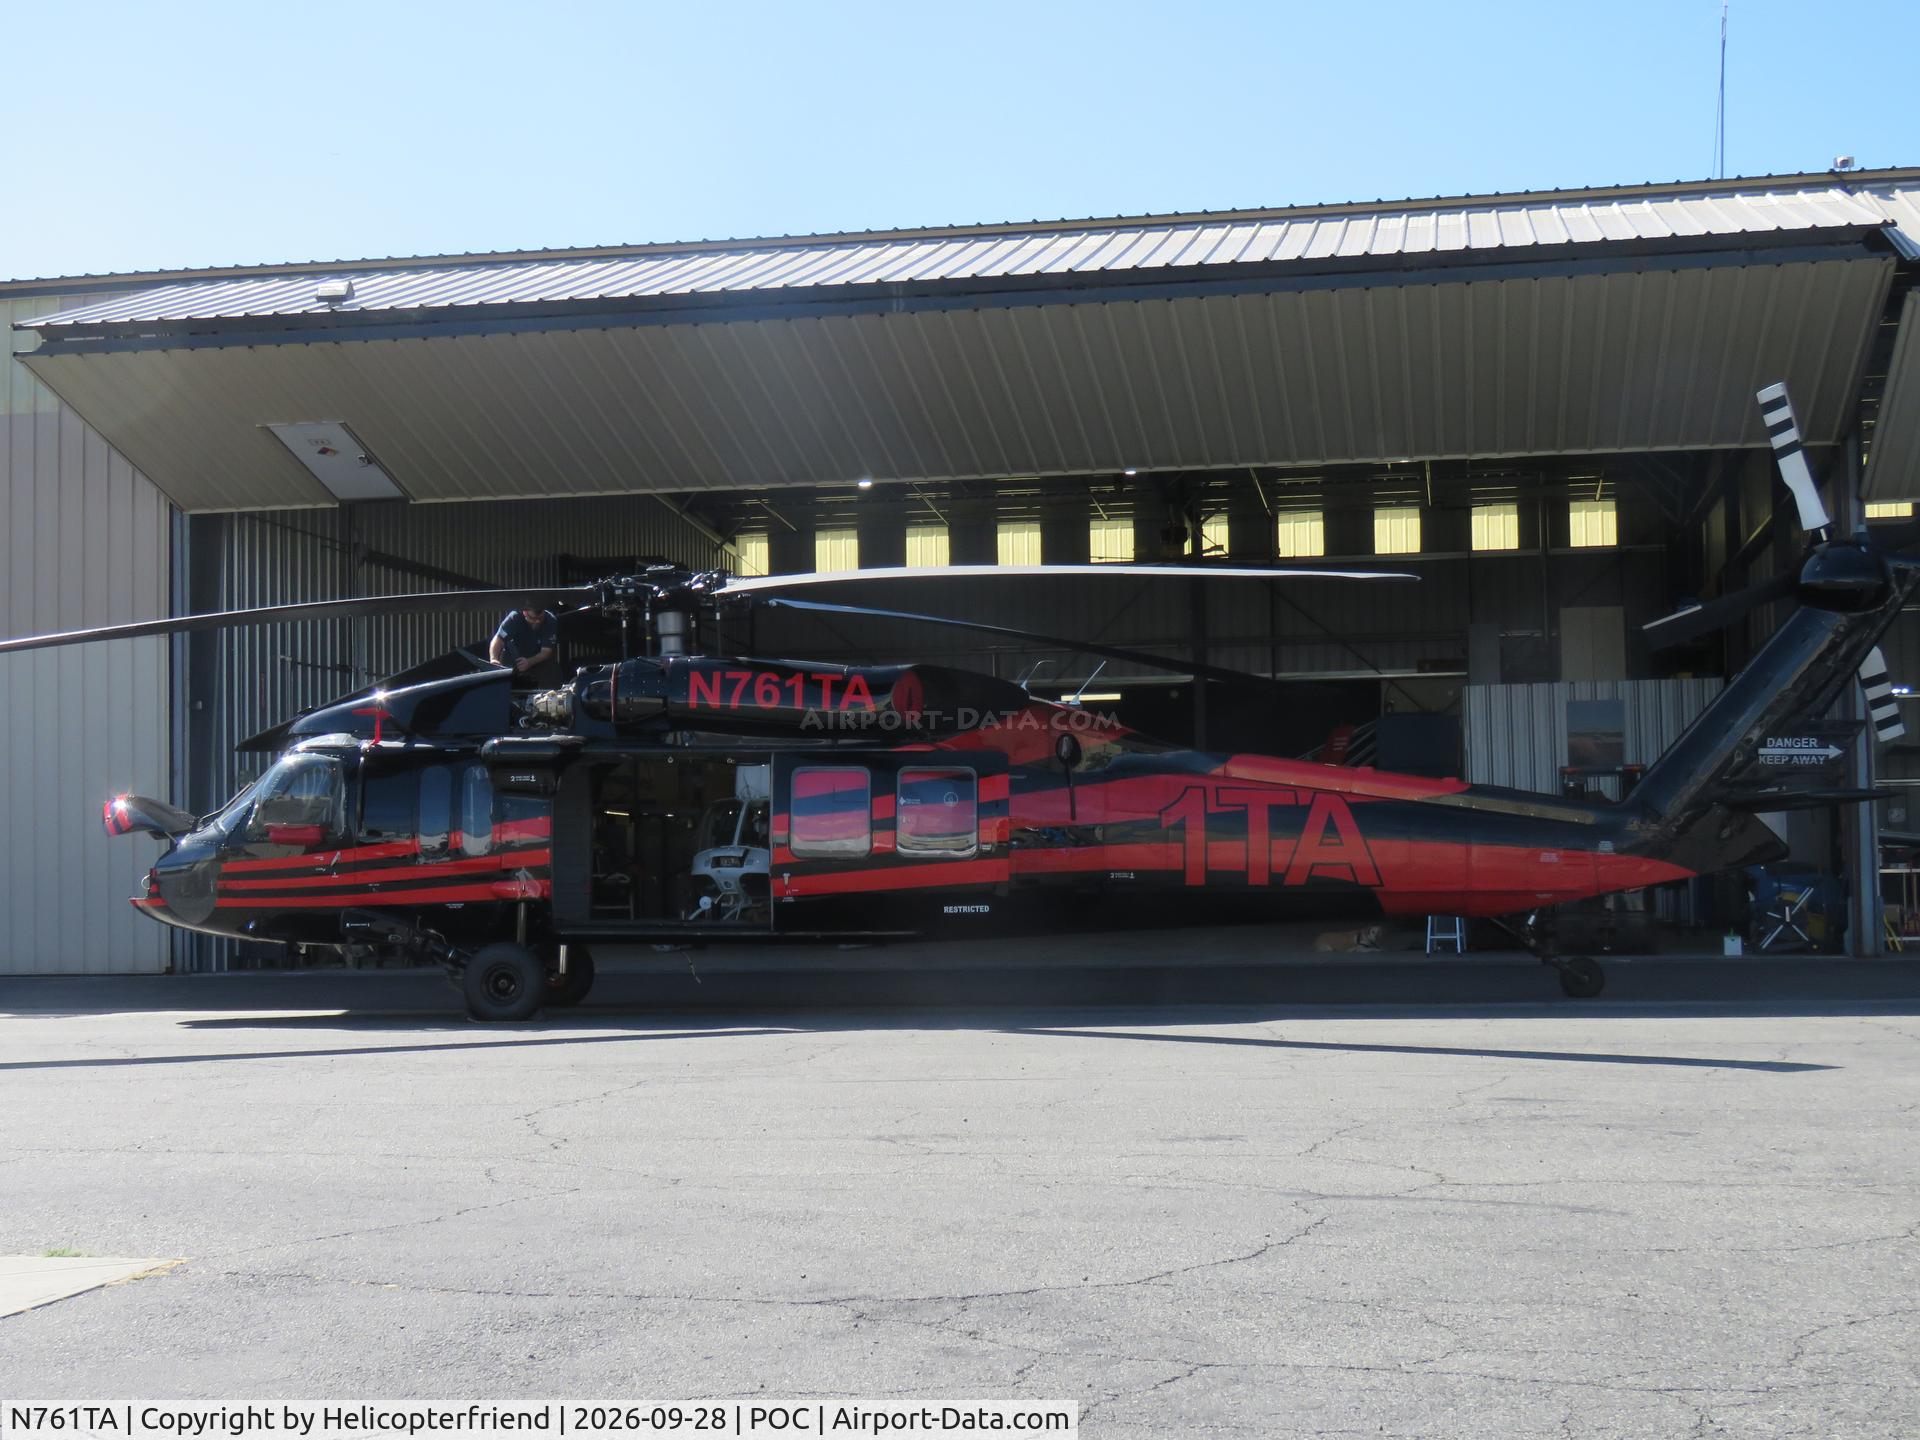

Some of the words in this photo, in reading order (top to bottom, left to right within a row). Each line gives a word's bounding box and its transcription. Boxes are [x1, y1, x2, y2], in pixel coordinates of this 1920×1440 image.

[688, 671, 876, 711] N761TA
[1766, 737, 1819, 748] DANGER
[1758, 755, 1789, 765] KEEP
[1791, 755, 1826, 765] AWAY
[1158, 786, 1384, 888] 1TA
[943, 905, 990, 914] RESTRICTED
